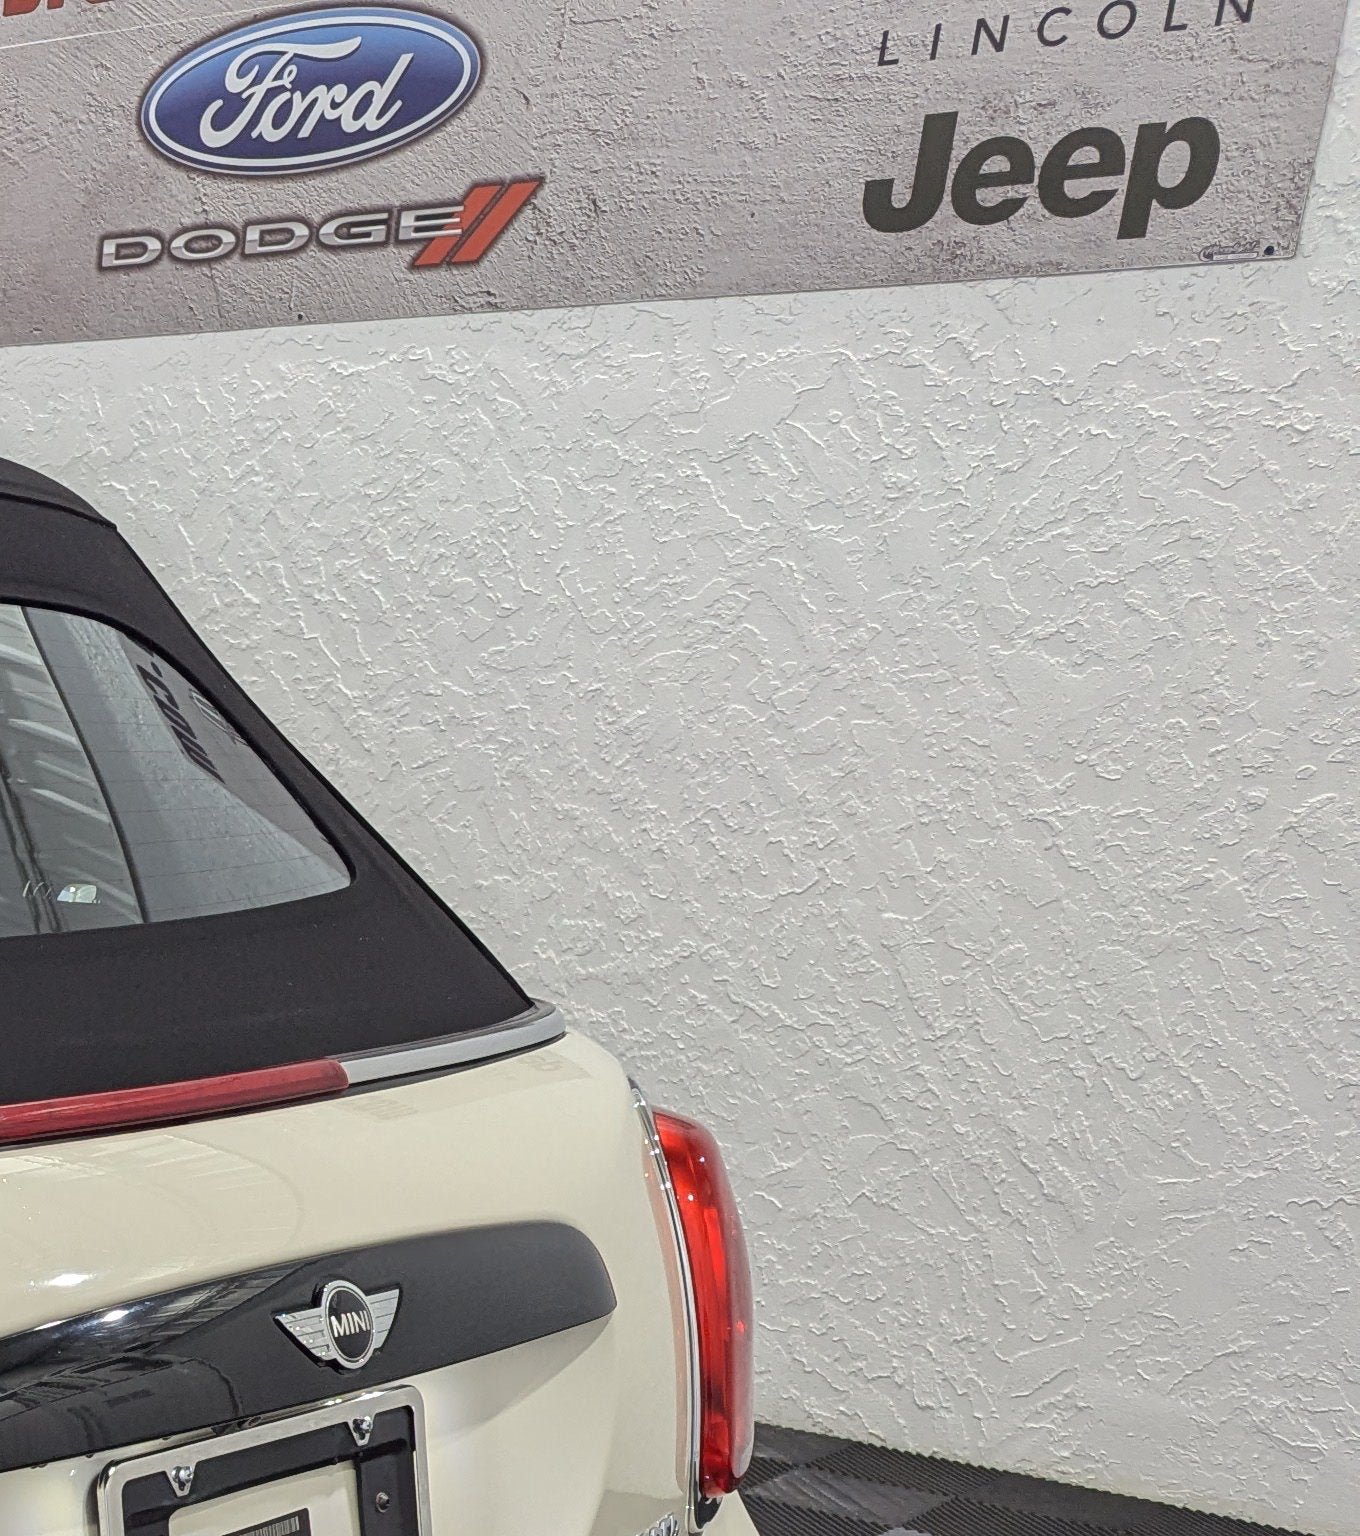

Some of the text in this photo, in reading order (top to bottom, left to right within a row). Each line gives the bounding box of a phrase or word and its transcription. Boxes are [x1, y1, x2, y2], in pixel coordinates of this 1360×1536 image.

[879, 0, 1254, 66] LINCOLN
[199, 36, 414, 147] Ford
[862, 111, 1221, 240] Jeep
[101, 205, 465, 268] DODGE
[330, 1310, 371, 1338] MINI
